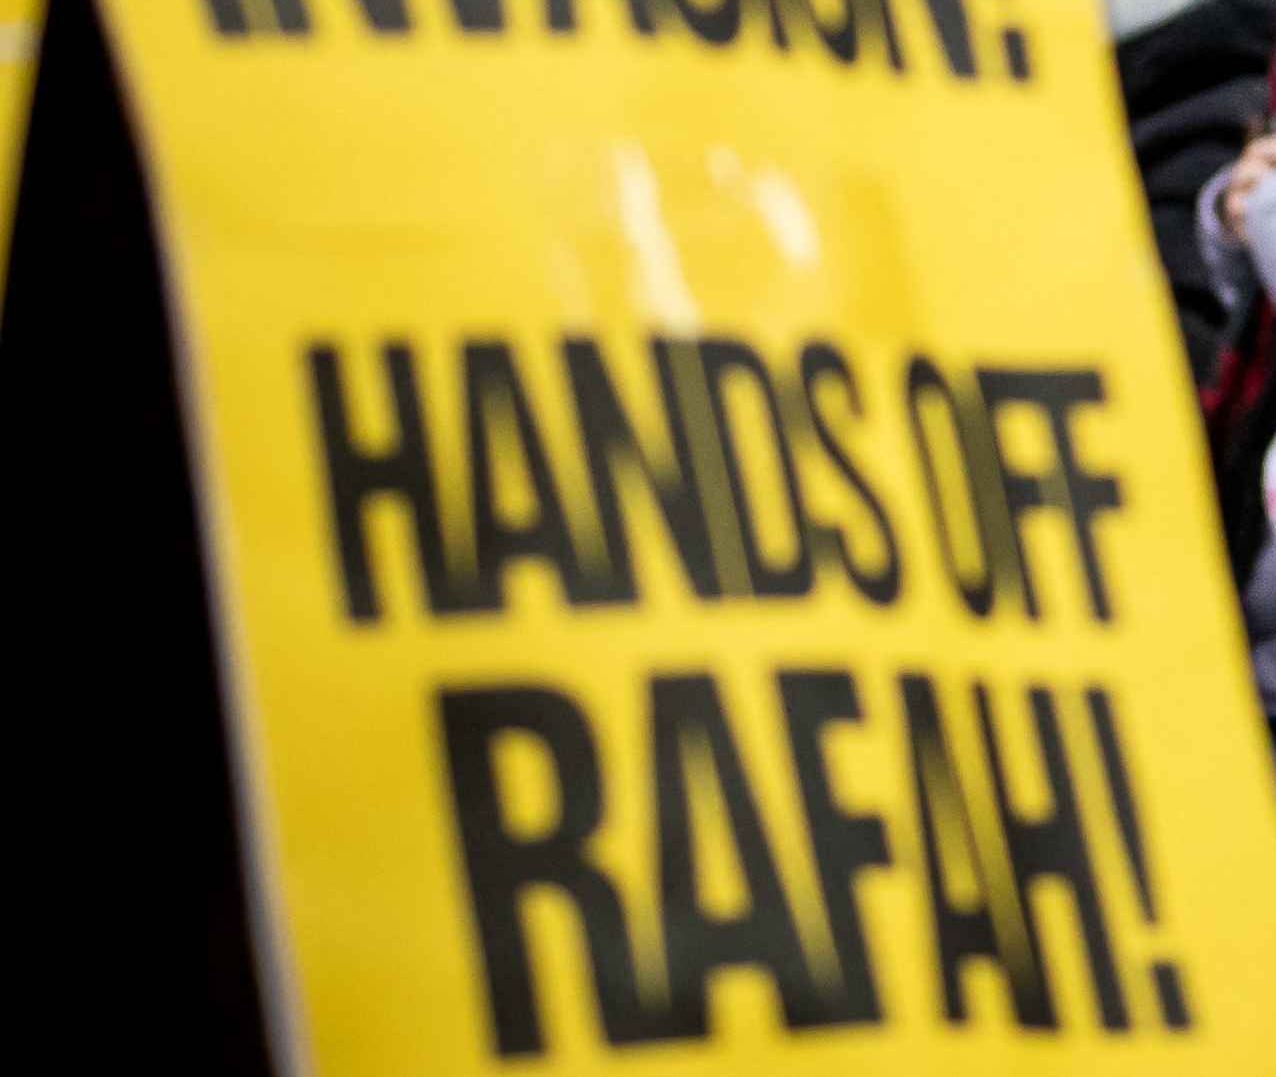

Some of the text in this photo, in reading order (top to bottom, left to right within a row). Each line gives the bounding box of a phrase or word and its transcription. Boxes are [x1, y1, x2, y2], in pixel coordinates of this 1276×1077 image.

[303, 335, 1126, 627] HANDS OFF
[433, 668, 1193, 1061] RAFAH!
